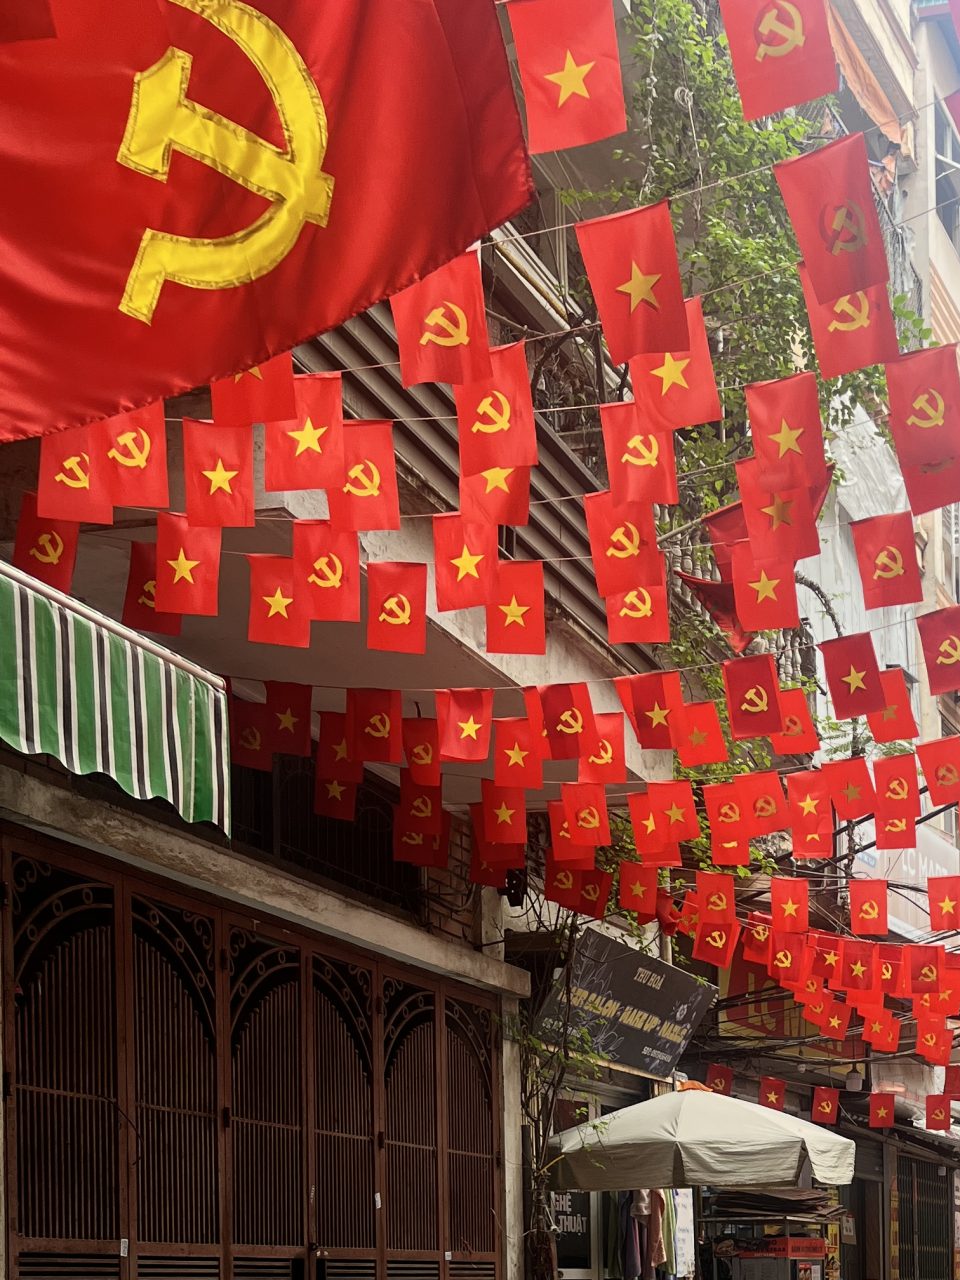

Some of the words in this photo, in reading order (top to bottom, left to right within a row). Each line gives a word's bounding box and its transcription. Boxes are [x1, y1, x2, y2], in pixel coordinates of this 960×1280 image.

[583, 992, 620, 1018] SALON
[619, 1005, 649, 1031] MAKE
[642, 1013, 661, 1033] UP
